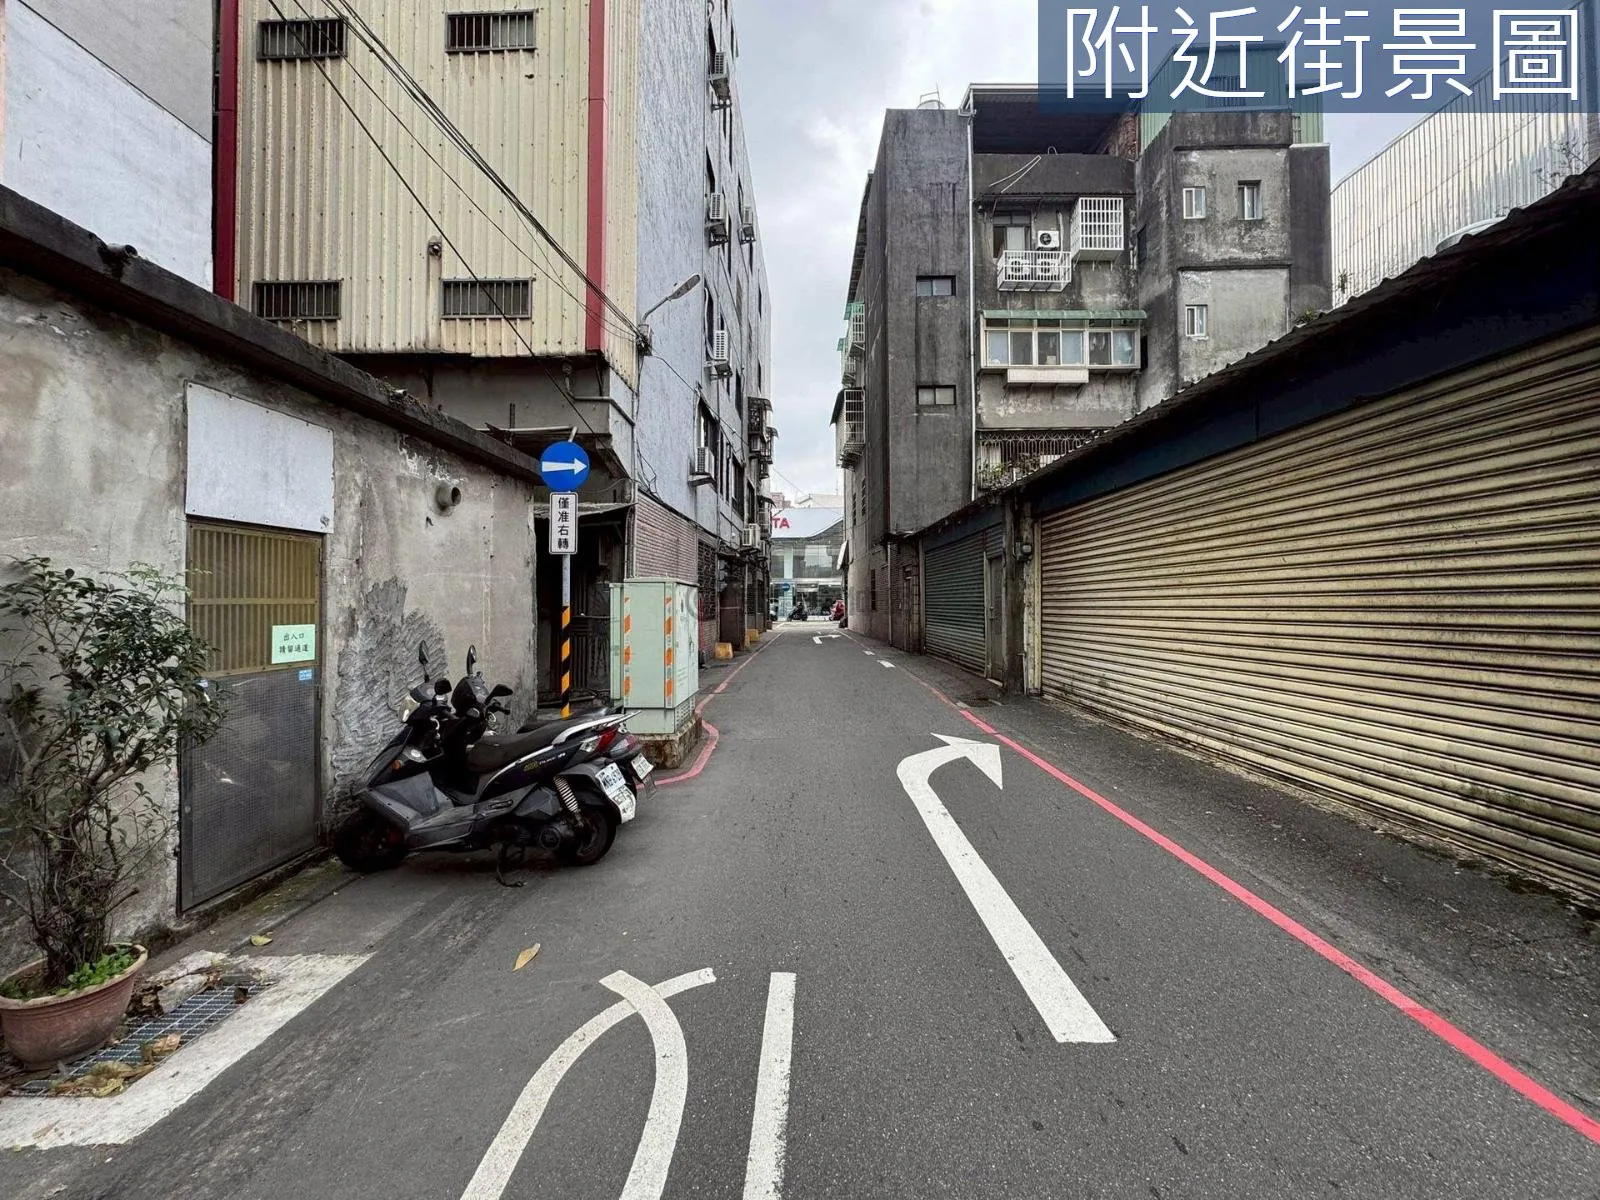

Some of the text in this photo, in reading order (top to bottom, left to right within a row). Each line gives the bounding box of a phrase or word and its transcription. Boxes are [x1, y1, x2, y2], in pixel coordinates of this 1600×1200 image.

[557, 496, 570, 550] 僅准右轉
[284, 632, 304, 641] 出入口
